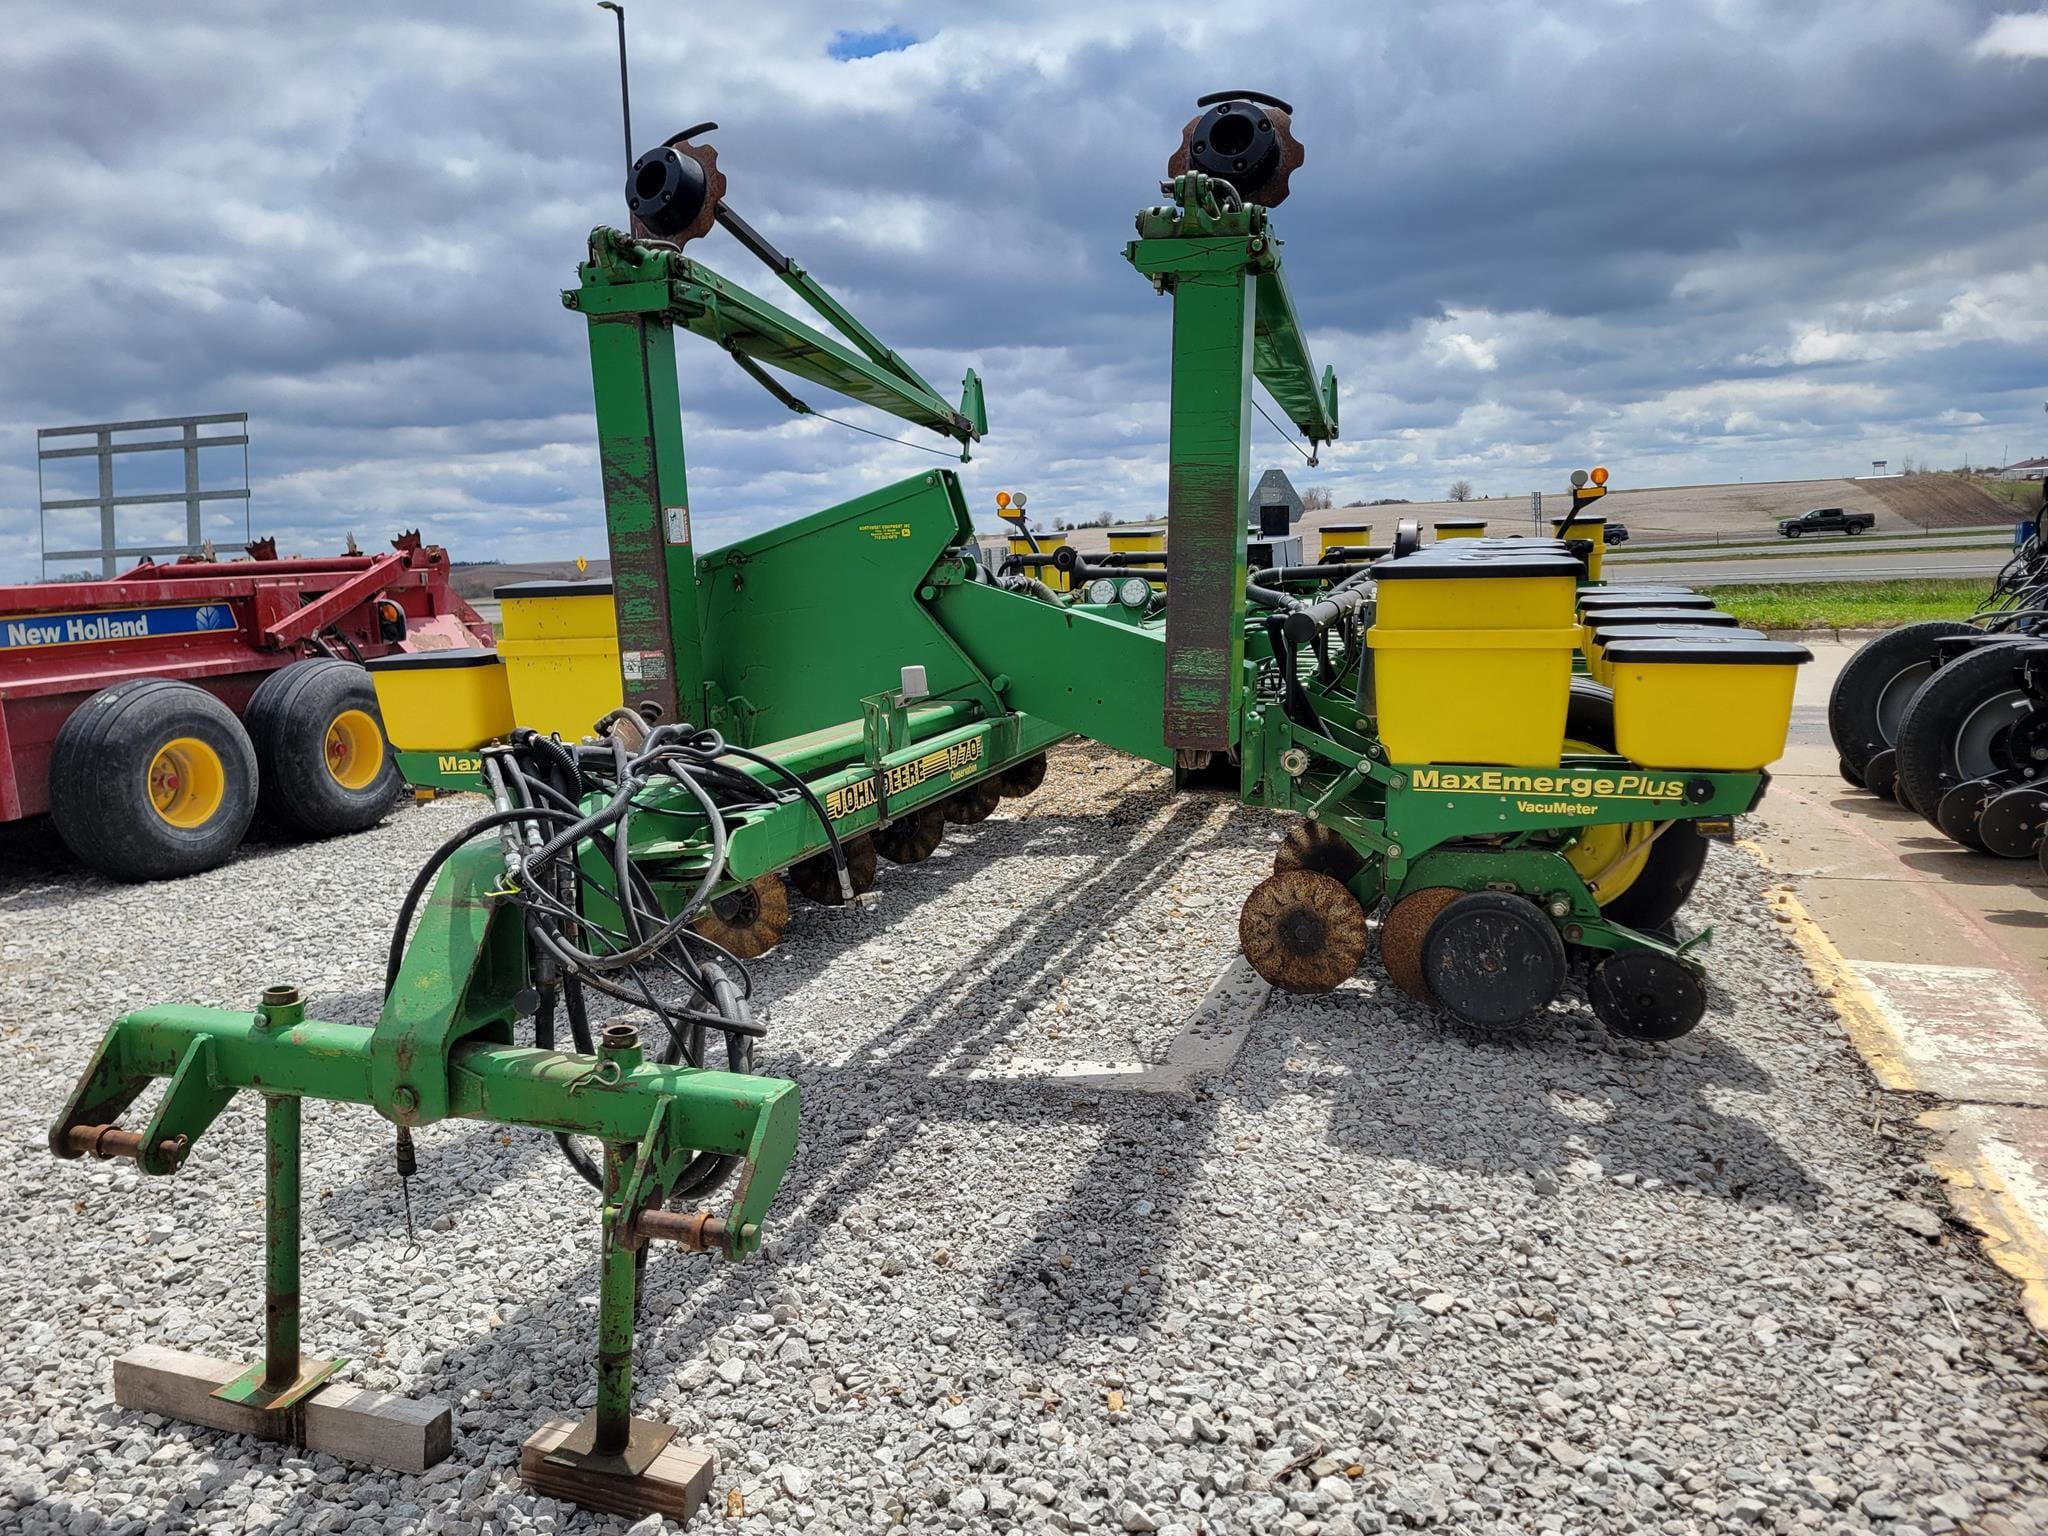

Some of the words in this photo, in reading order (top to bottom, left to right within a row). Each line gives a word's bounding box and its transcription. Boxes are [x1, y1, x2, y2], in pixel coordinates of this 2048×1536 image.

[7, 623, 61, 647] New
[66, 615, 149, 641] Holland
[835, 775, 879, 817] JOHN
[884, 759, 925, 795] DEERE
[946, 739, 979, 769] 1770
[1517, 801, 1599, 815] VacuMeter
